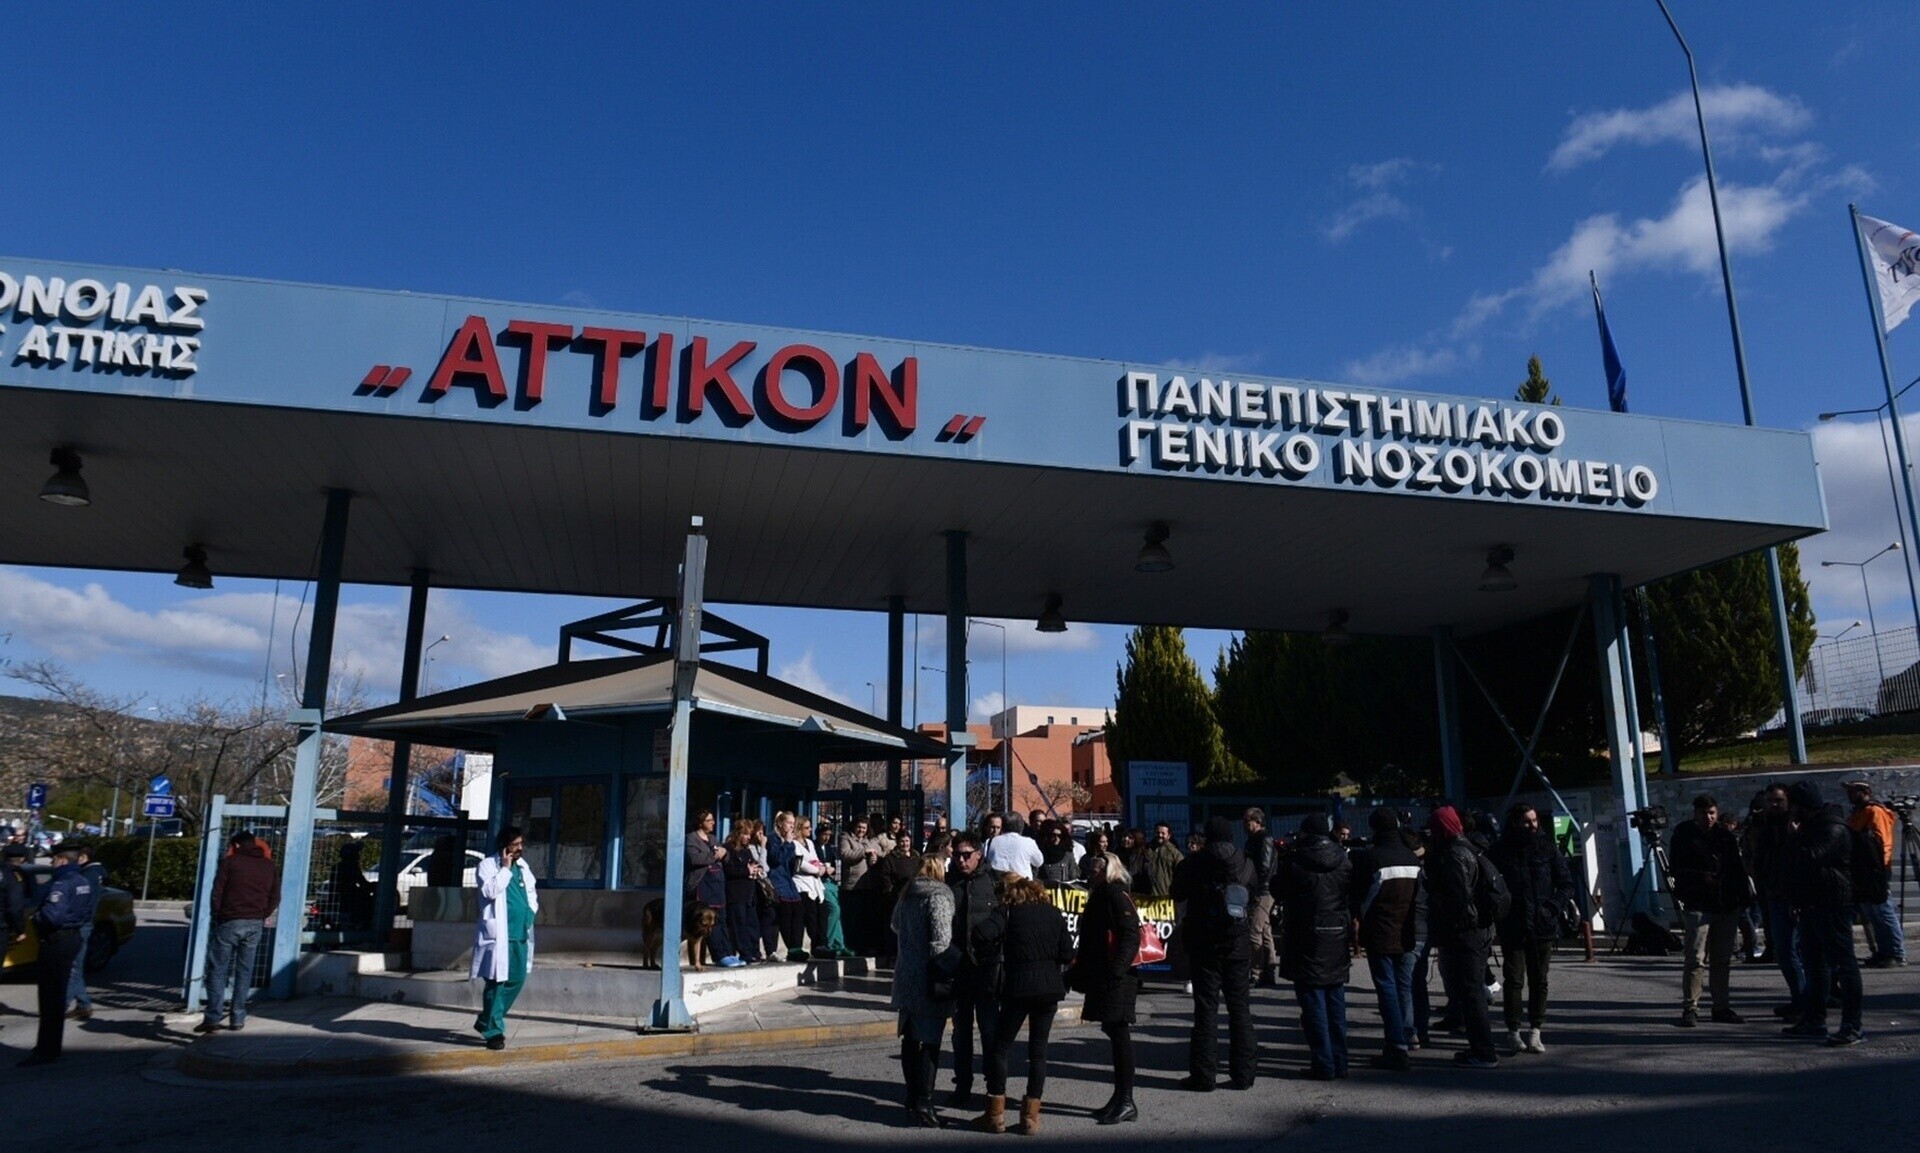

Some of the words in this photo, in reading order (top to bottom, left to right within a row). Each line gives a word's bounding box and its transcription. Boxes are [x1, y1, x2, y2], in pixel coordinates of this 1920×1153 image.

[18, 324, 201, 372] ΑΤΤΙΚΗΣ
[1127, 371, 1566, 449] ΠΑΝΕΠΙΣΤΗΜΙΑΚΟ
[1127, 420, 1320, 474] ΓΕΝΙΚΟ
[1342, 440, 1659, 503] ΝΟΣΟΚΟΜΕΙΟ
